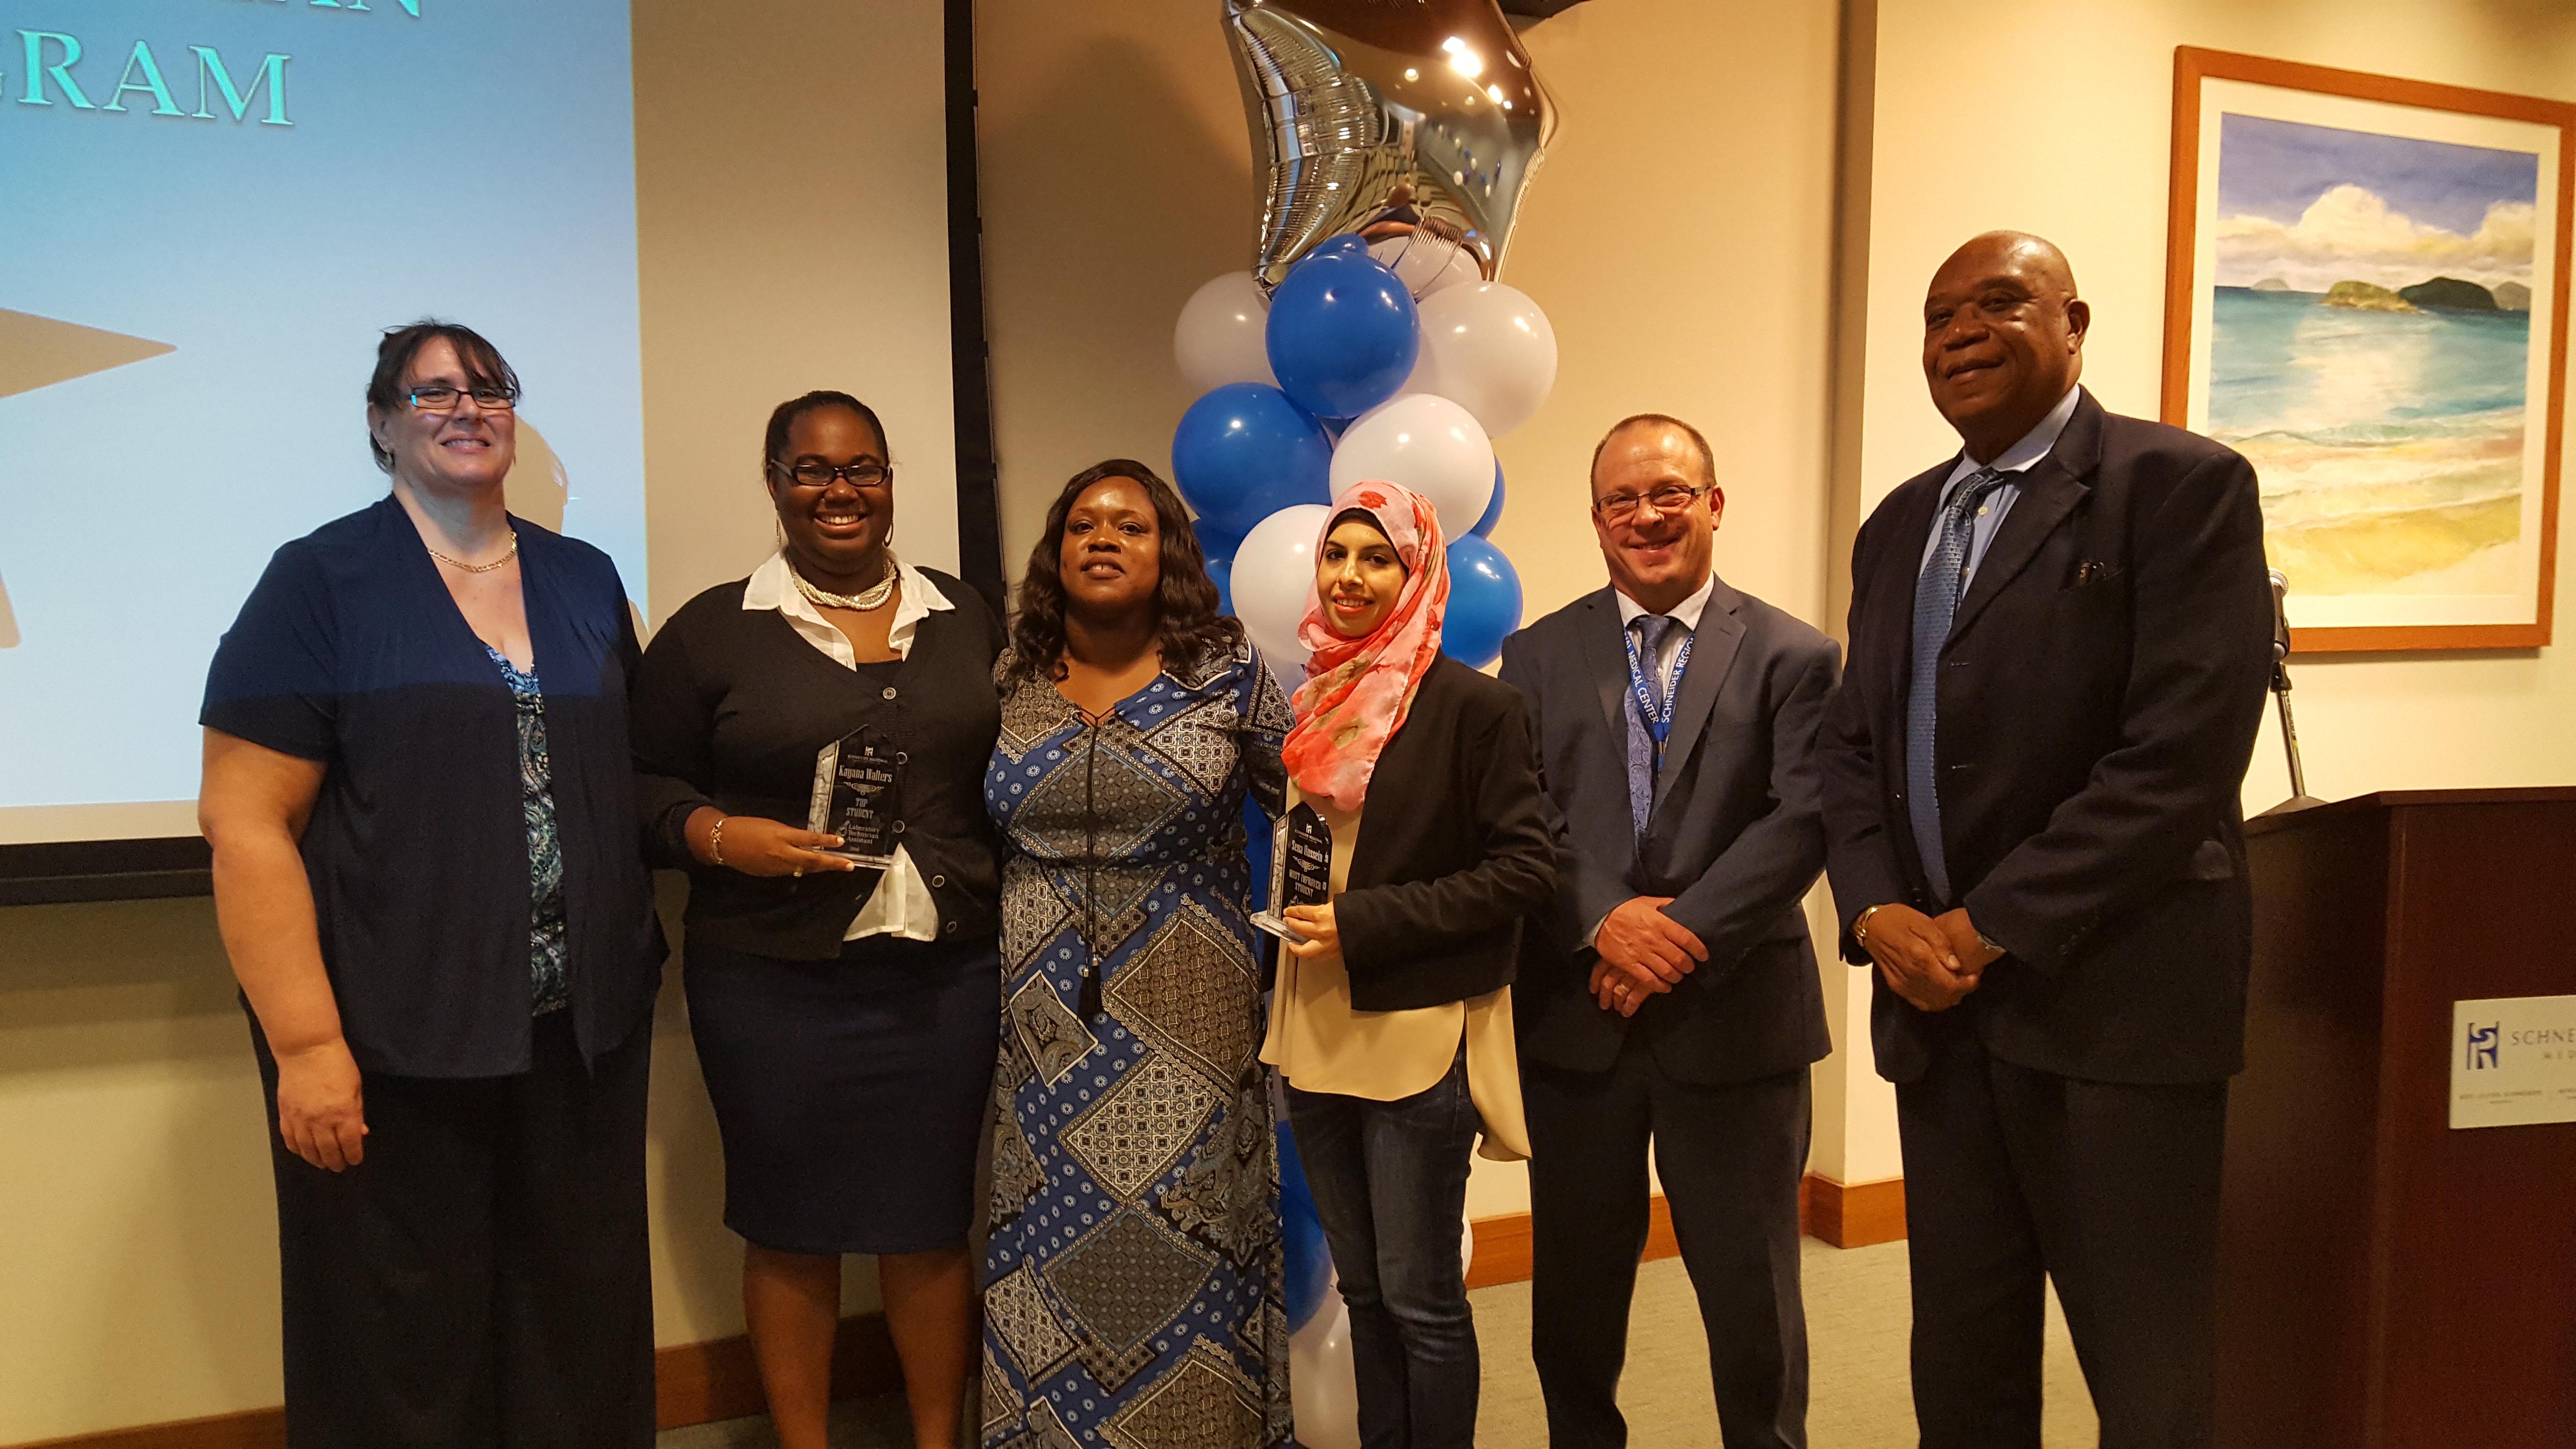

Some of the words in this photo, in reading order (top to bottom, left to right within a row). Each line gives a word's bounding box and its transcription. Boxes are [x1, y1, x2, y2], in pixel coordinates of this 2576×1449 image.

[0, 29, 293, 125] RAM
[1628, 650, 1643, 687] MEDICAL
[1638, 687, 1659, 724] CENTER
[1661, 670, 1681, 723] SCHNEIDER
[866, 768, 892, 783] Walters
[855, 797, 868, 807] TOP
[846, 807, 874, 819] STUDENT
[848, 824, 880, 835] Laboratory
[848, 830, 879, 839] Technician
[847, 836, 873, 844] Assistant
[1304, 845, 1323, 863] Hussein
[1289, 869, 1300, 881] MOST
[1294, 882, 1314, 898] STUDENT
